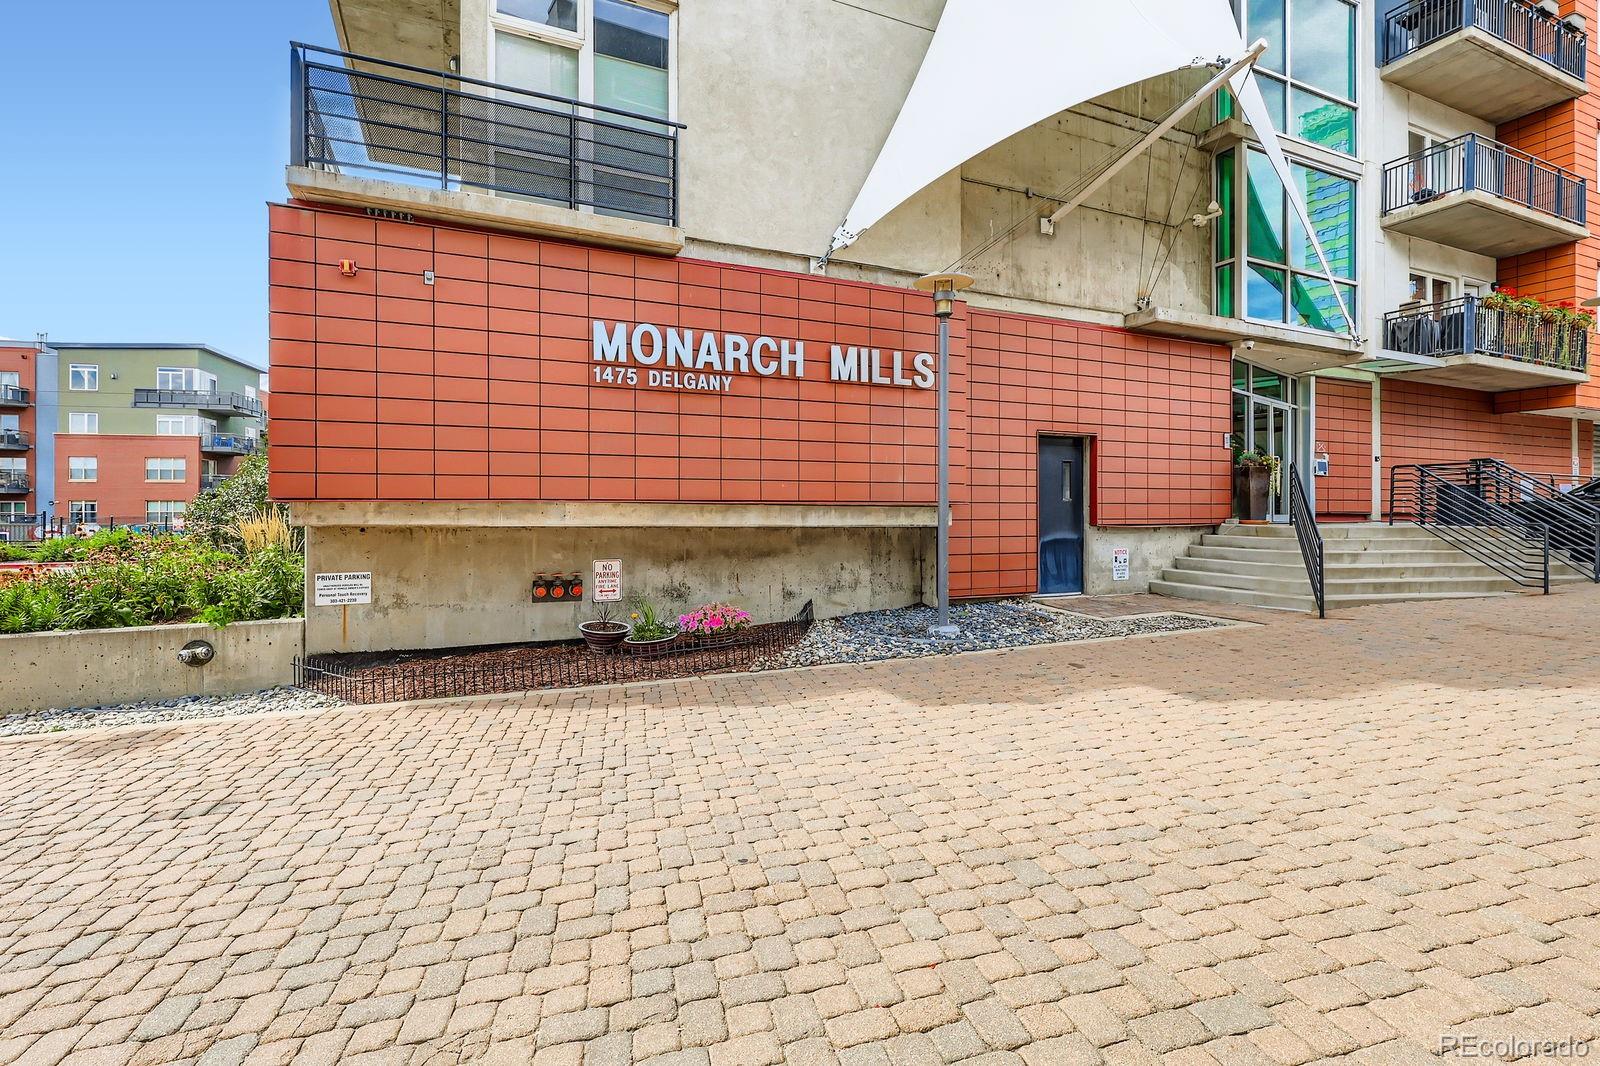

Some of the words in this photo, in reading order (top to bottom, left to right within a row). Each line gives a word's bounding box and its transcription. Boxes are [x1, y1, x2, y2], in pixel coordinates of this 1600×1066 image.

[592, 320, 805, 378] MONARCH
[830, 344, 935, 389] MILLS
[593, 366, 638, 386] 1475
[648, 370, 733, 392] DELGANY
